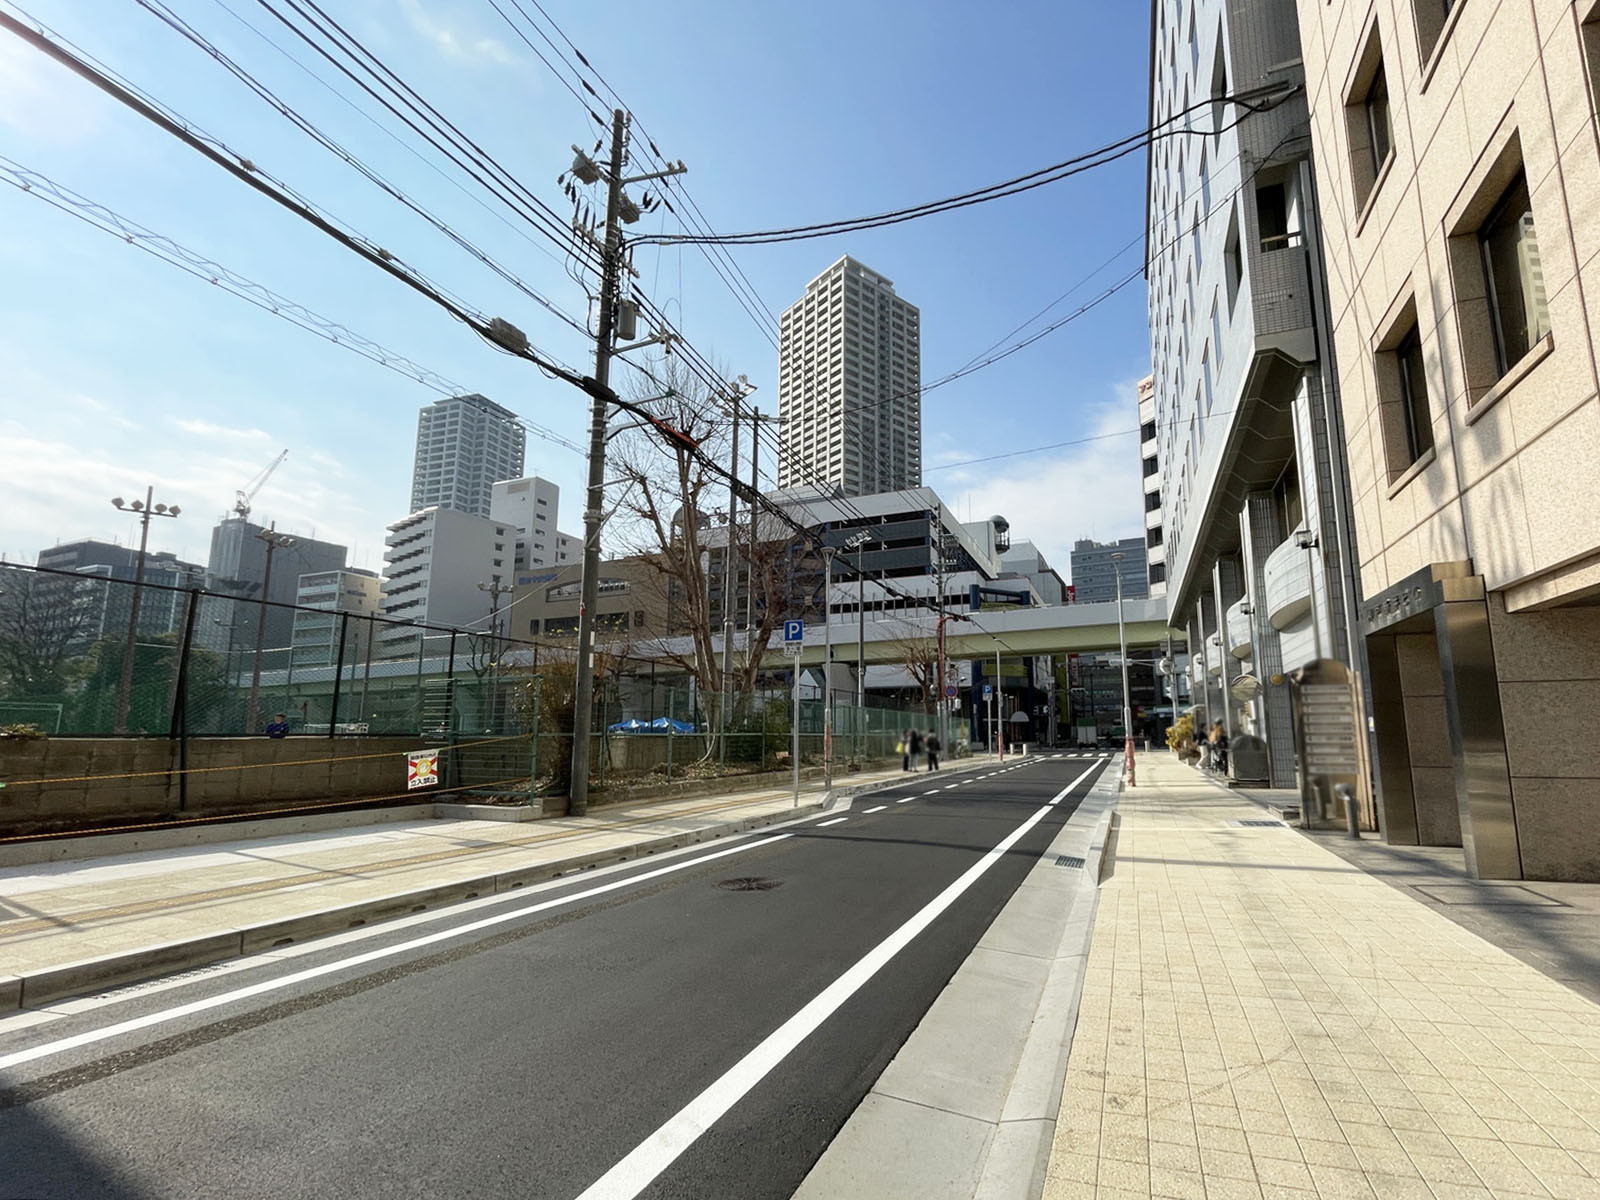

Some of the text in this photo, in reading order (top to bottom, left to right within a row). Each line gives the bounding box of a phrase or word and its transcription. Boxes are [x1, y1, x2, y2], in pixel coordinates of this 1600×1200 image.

[788, 622, 800, 639] P
[410, 776, 436, 787] 立入禁止
